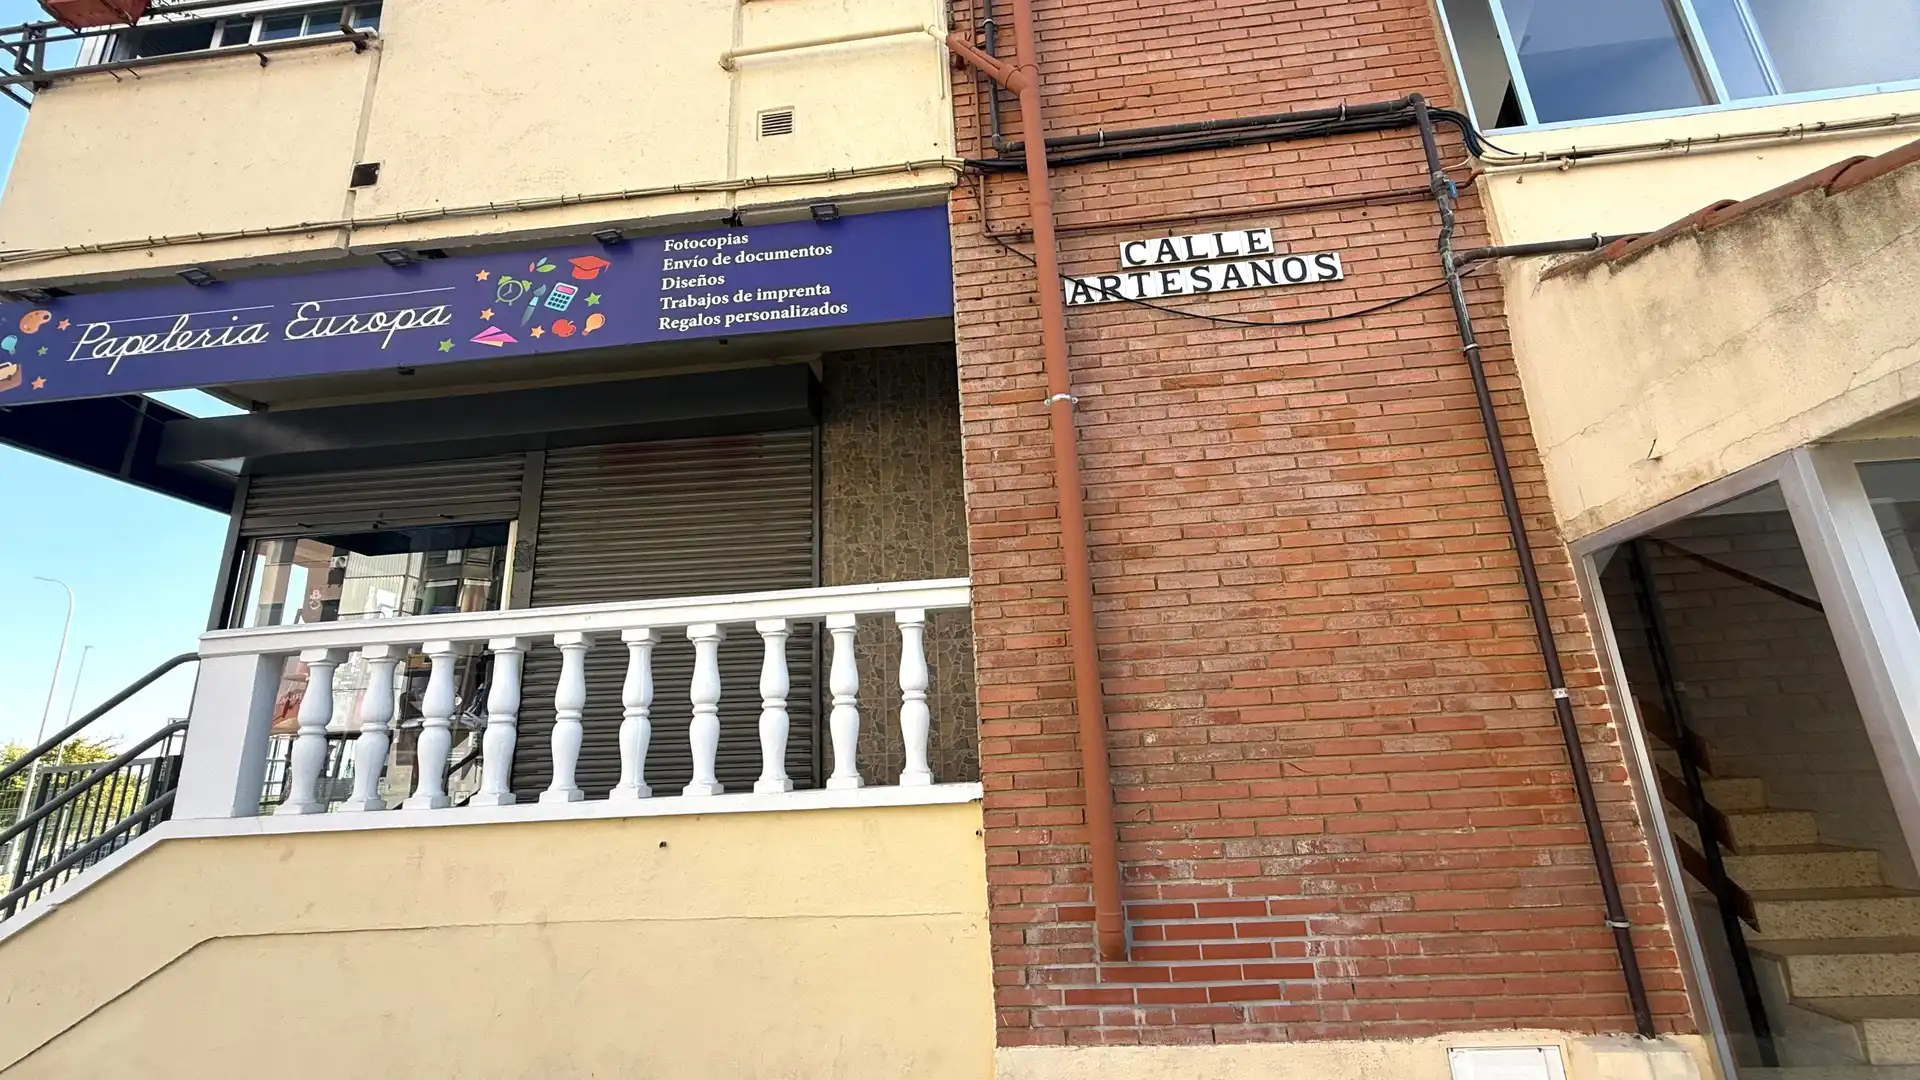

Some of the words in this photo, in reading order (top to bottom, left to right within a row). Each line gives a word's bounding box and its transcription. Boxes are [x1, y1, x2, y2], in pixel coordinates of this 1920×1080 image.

[664, 233, 749, 252] Fotocopias
[1124, 229, 1270, 264] CALLE
[662, 256, 708, 271] Envío
[711, 250, 731, 265] de
[734, 244, 833, 264] documentos
[661, 274, 726, 290] Diseños
[1068, 252, 1339, 304] ARTESANOS
[660, 292, 729, 310] Trabajos
[732, 290, 753, 303] de
[756, 283, 831, 303] imprenta
[659, 315, 721, 332] Regalos
[724, 302, 848, 328] personalizados
[69, 314, 268, 375] Papeleria
[284, 301, 452, 349] Europa
